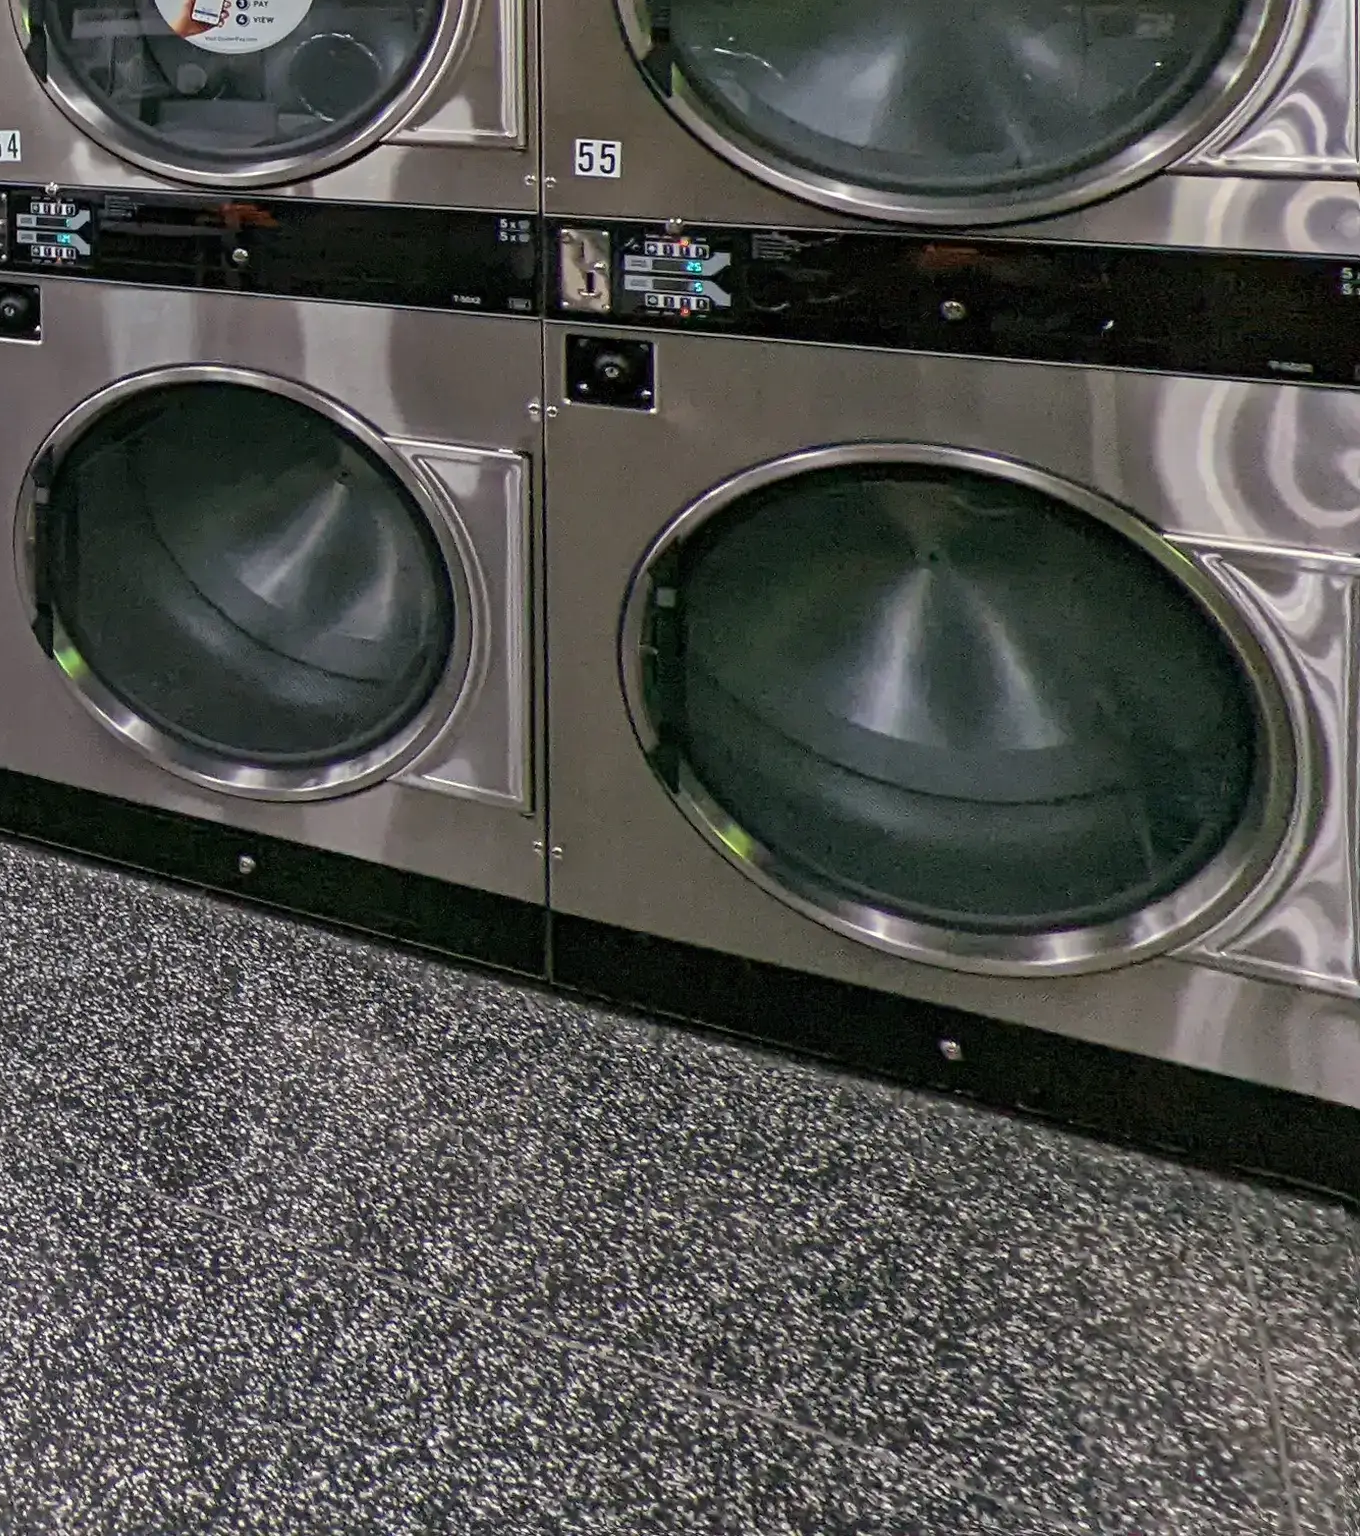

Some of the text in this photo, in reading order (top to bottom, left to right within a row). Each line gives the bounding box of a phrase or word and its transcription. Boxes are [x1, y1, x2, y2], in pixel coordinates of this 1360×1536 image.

[253, 0, 269, 8] PAY
[253, 15, 275, 24] VIEW
[578, 142, 616, 174] 55
